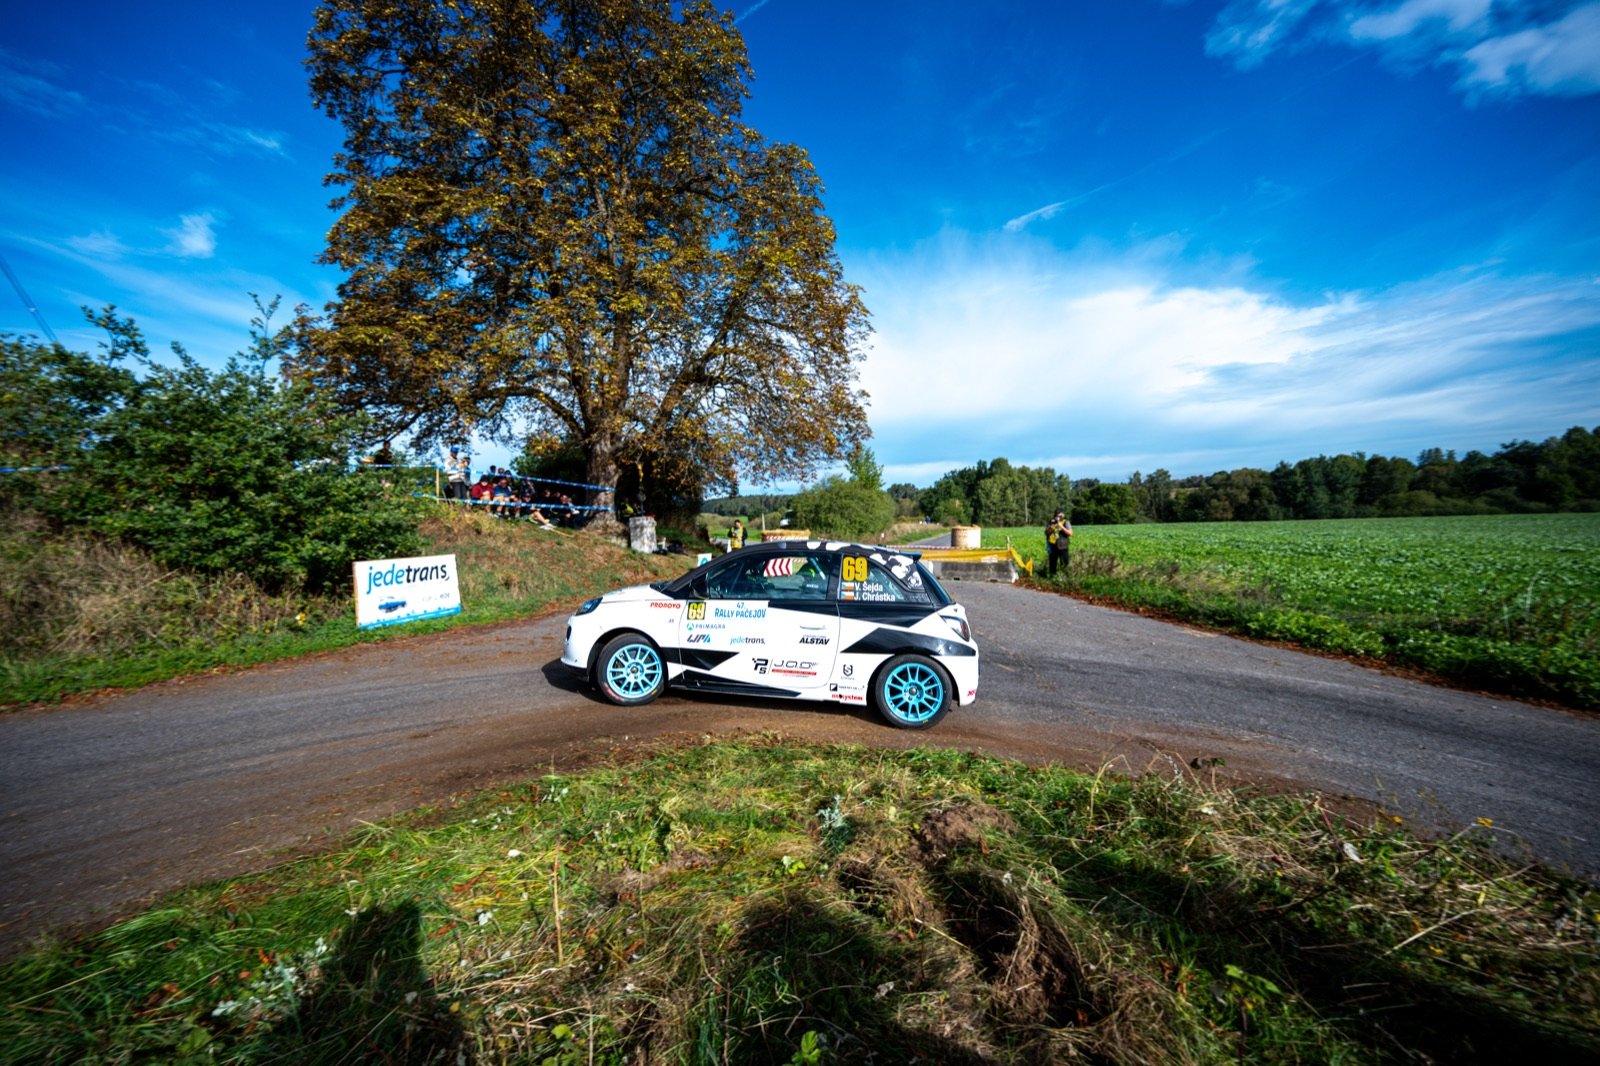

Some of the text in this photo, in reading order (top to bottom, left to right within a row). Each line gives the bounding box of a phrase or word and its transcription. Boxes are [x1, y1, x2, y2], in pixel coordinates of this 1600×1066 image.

[842, 556, 868, 582] 69
[854, 581, 883, 593] V. Šejda
[853, 591, 896, 602] J. Chrástka
[688, 602, 705, 619] 69
[714, 608, 767, 619] RALLY PAČEJOV
[799, 637, 830, 646] ALSTAV
